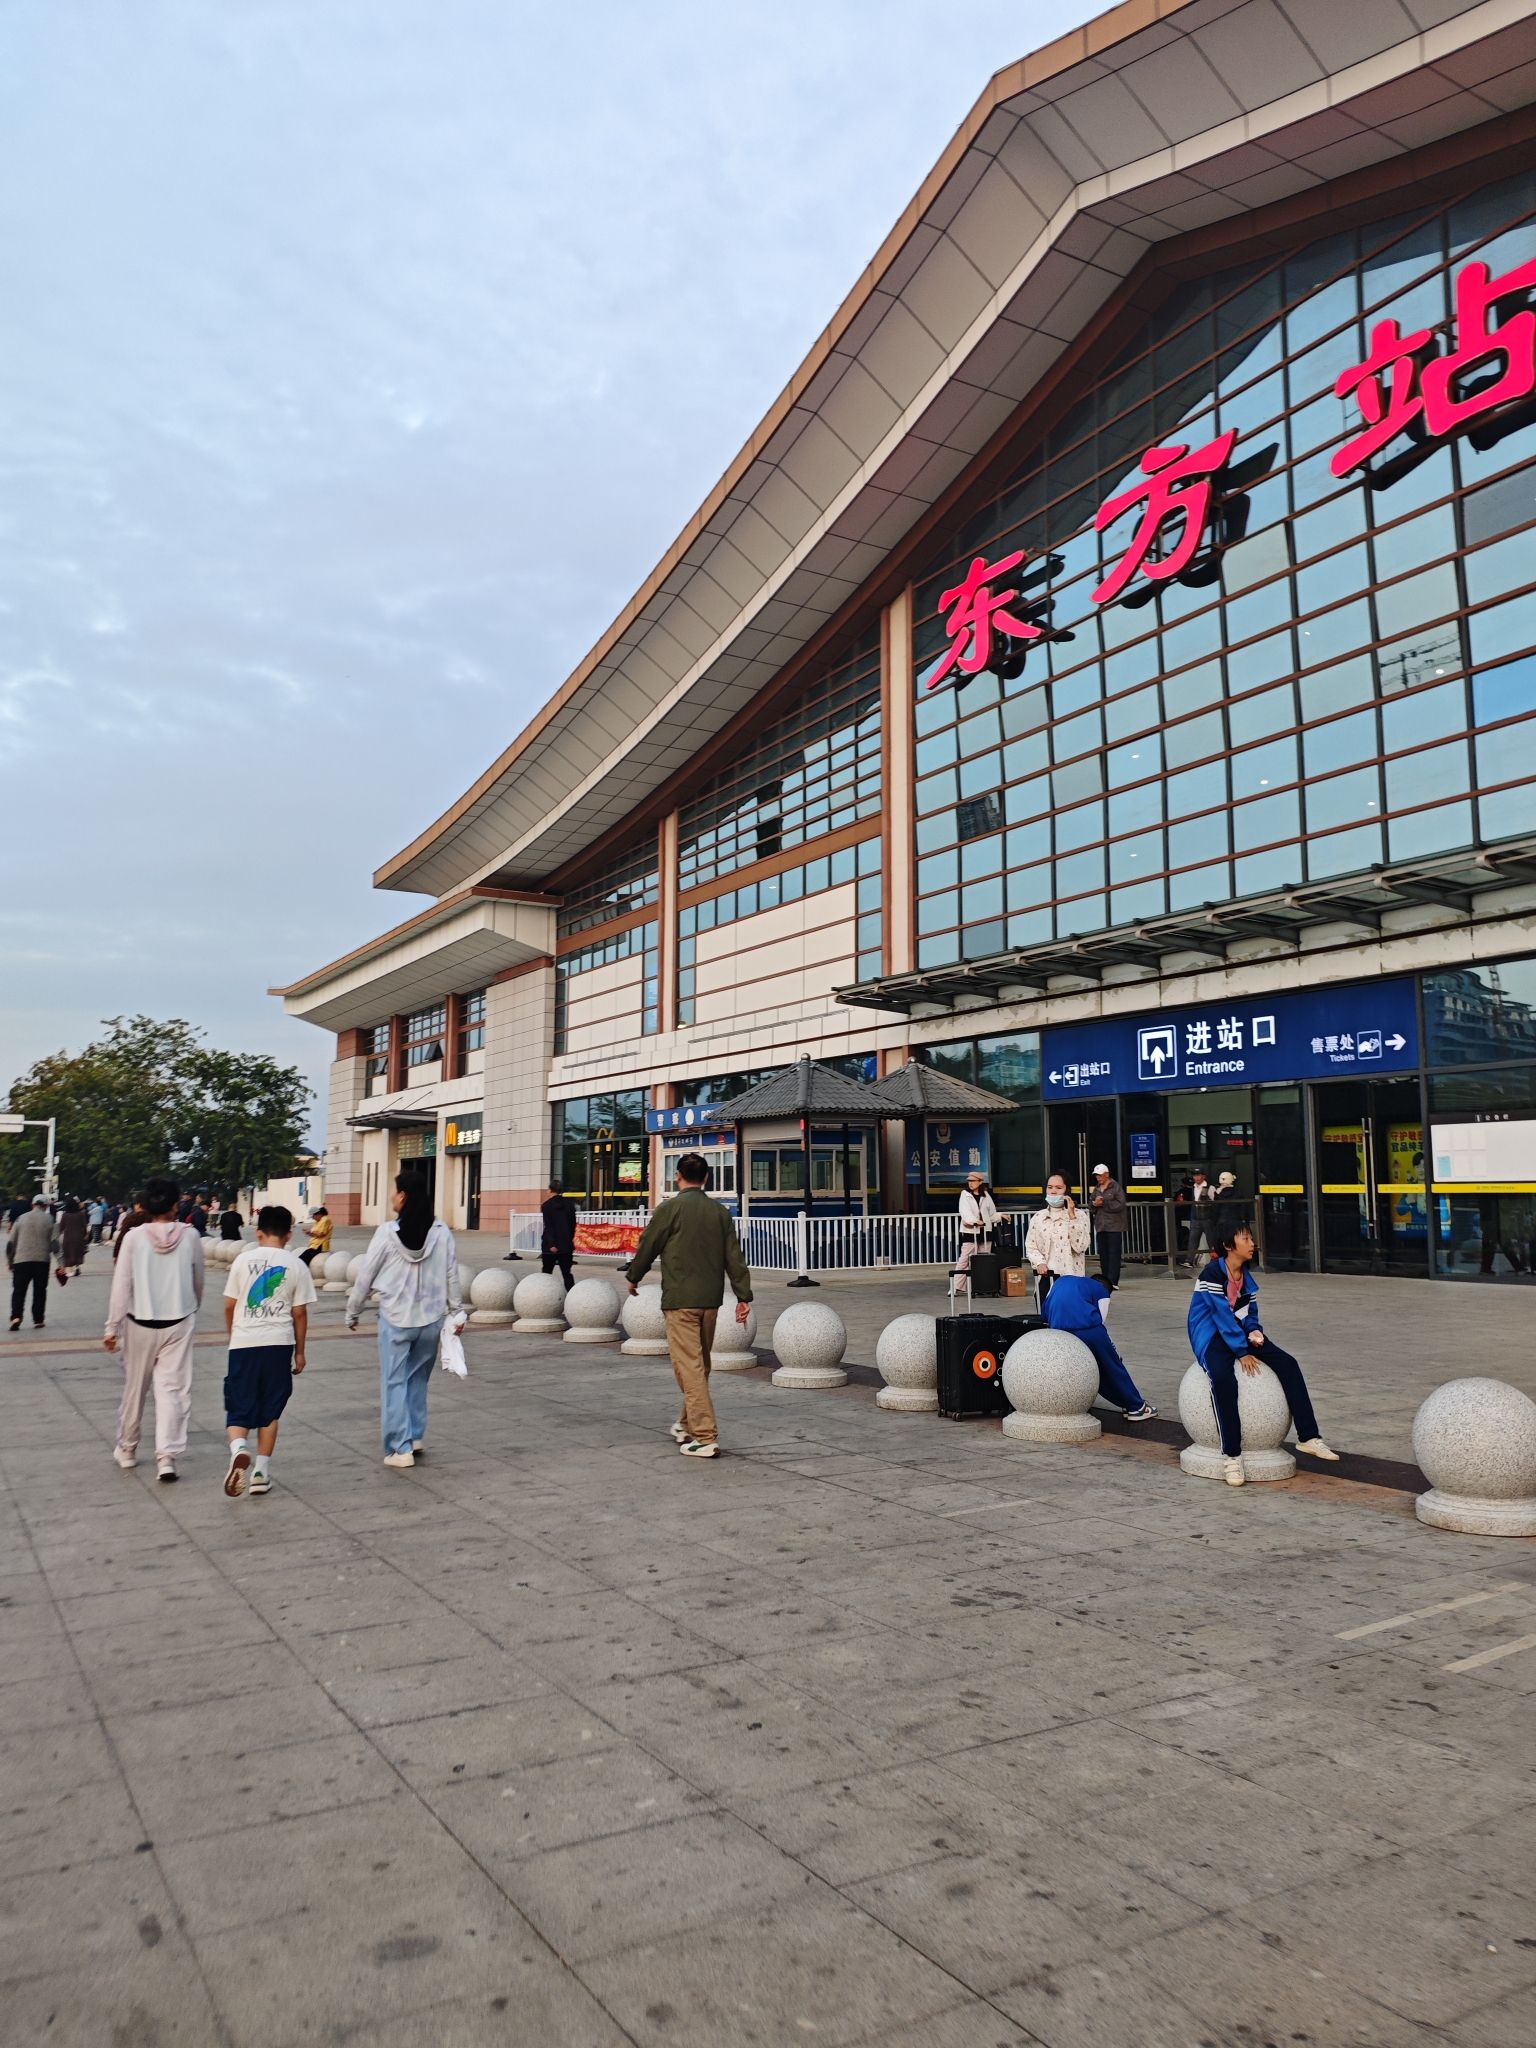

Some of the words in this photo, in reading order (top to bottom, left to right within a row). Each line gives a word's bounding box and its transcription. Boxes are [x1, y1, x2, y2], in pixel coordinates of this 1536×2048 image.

[926, 261, 1536, 690] 东方站
[1185, 1015, 1276, 1055] 进站口
[1310, 1033, 1355, 1054] 售票处
[1185, 1058, 1245, 1076] Entrance
[1329, 1053, 1356, 1063] Tickets
[1079, 1062, 1111, 1078] 出站口
[457, 1129, 481, 1145] 麦当劳
[911, 1147, 981, 1167] 公安值勤
